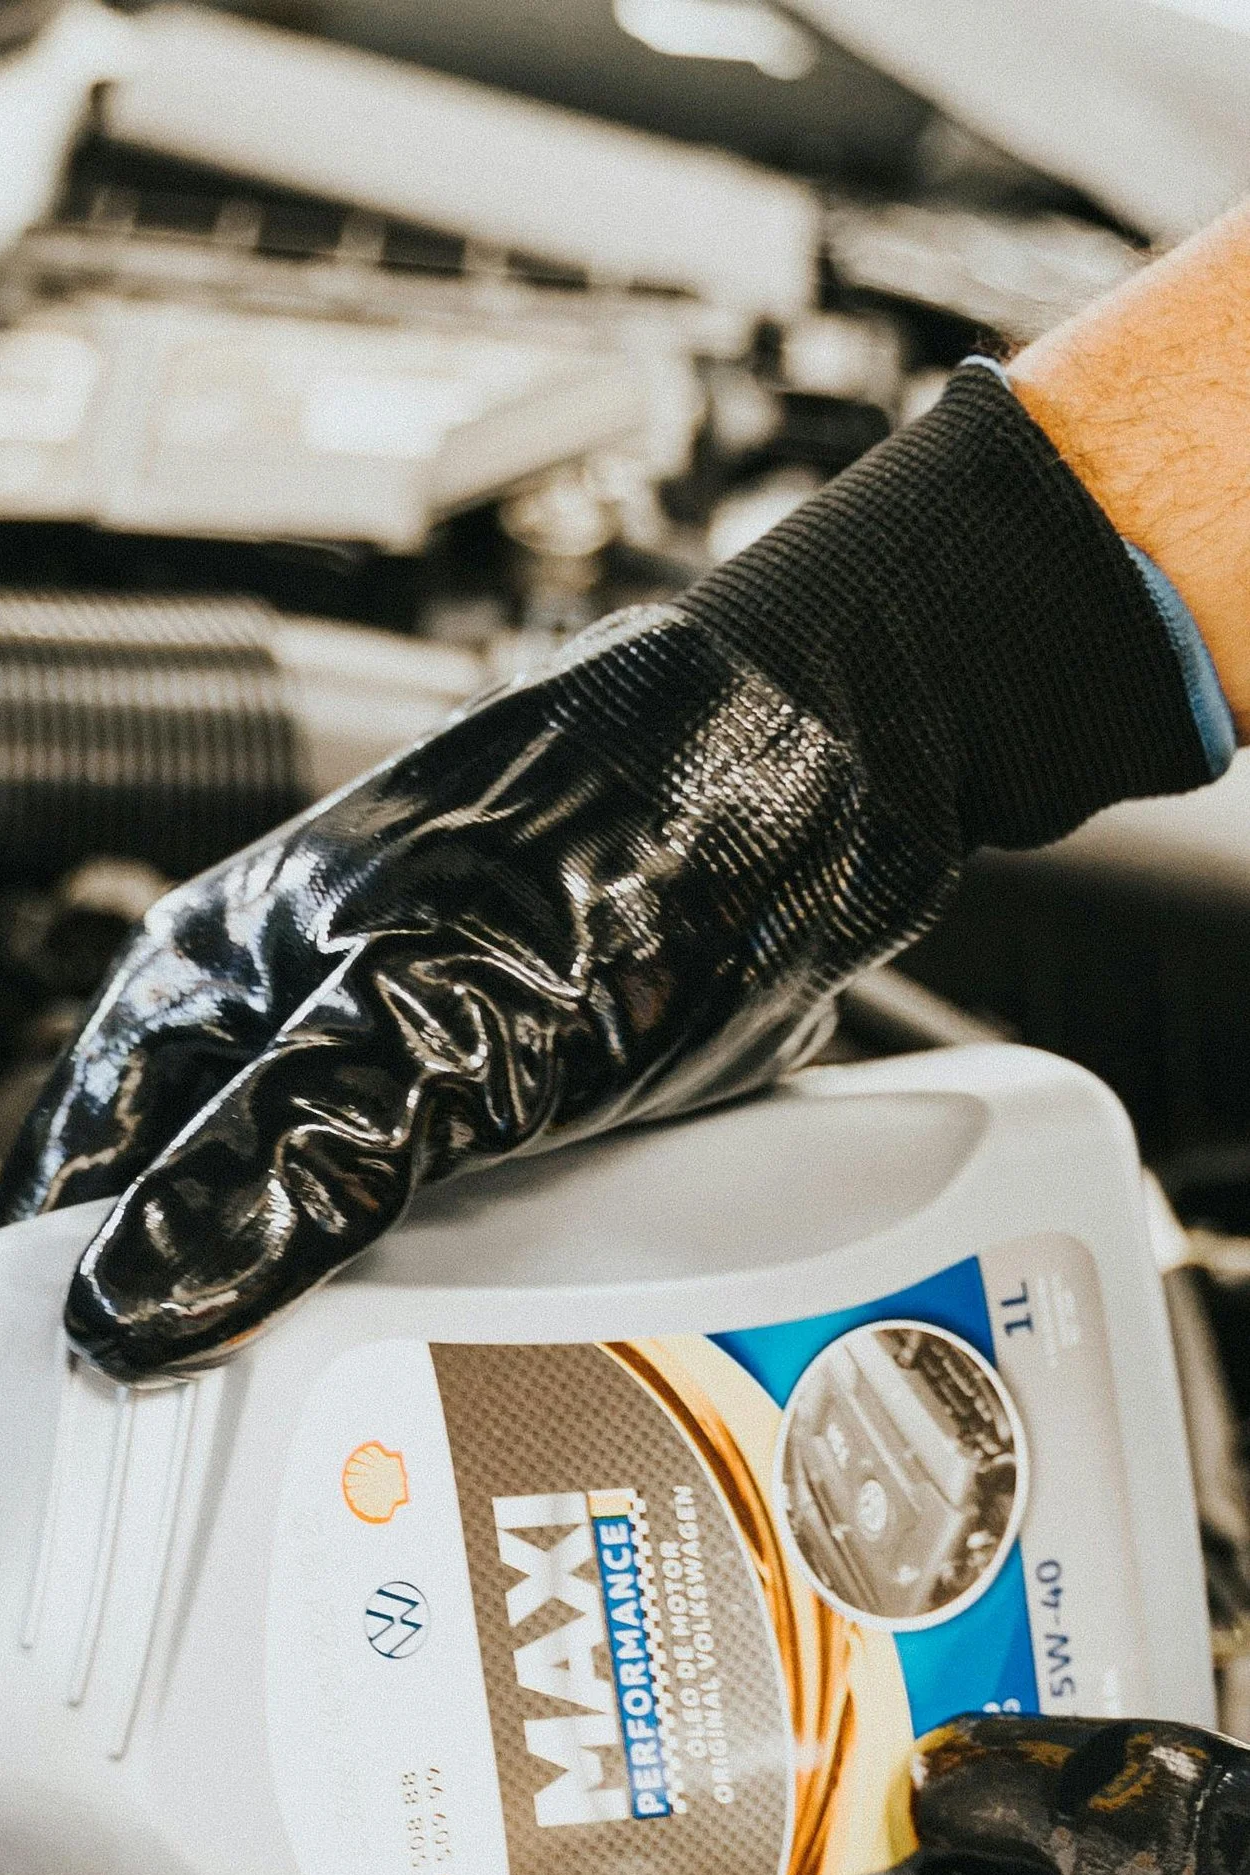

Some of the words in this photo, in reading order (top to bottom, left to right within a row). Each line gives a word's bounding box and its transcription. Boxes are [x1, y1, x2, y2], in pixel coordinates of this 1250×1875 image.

[1000, 1281, 1034, 1338] 1L
[658, 1540, 693, 1638] MOTOR
[671, 1484, 720, 1672] VOLKSWAGEN
[1034, 1558, 1075, 1699] 5W-40
[491, 1490, 630, 1828] MAXI
[599, 1522, 666, 1816] PERFORMANCE
[672, 1643, 699, 1681] DE
[699, 1675, 735, 1804] ORIGINAL
